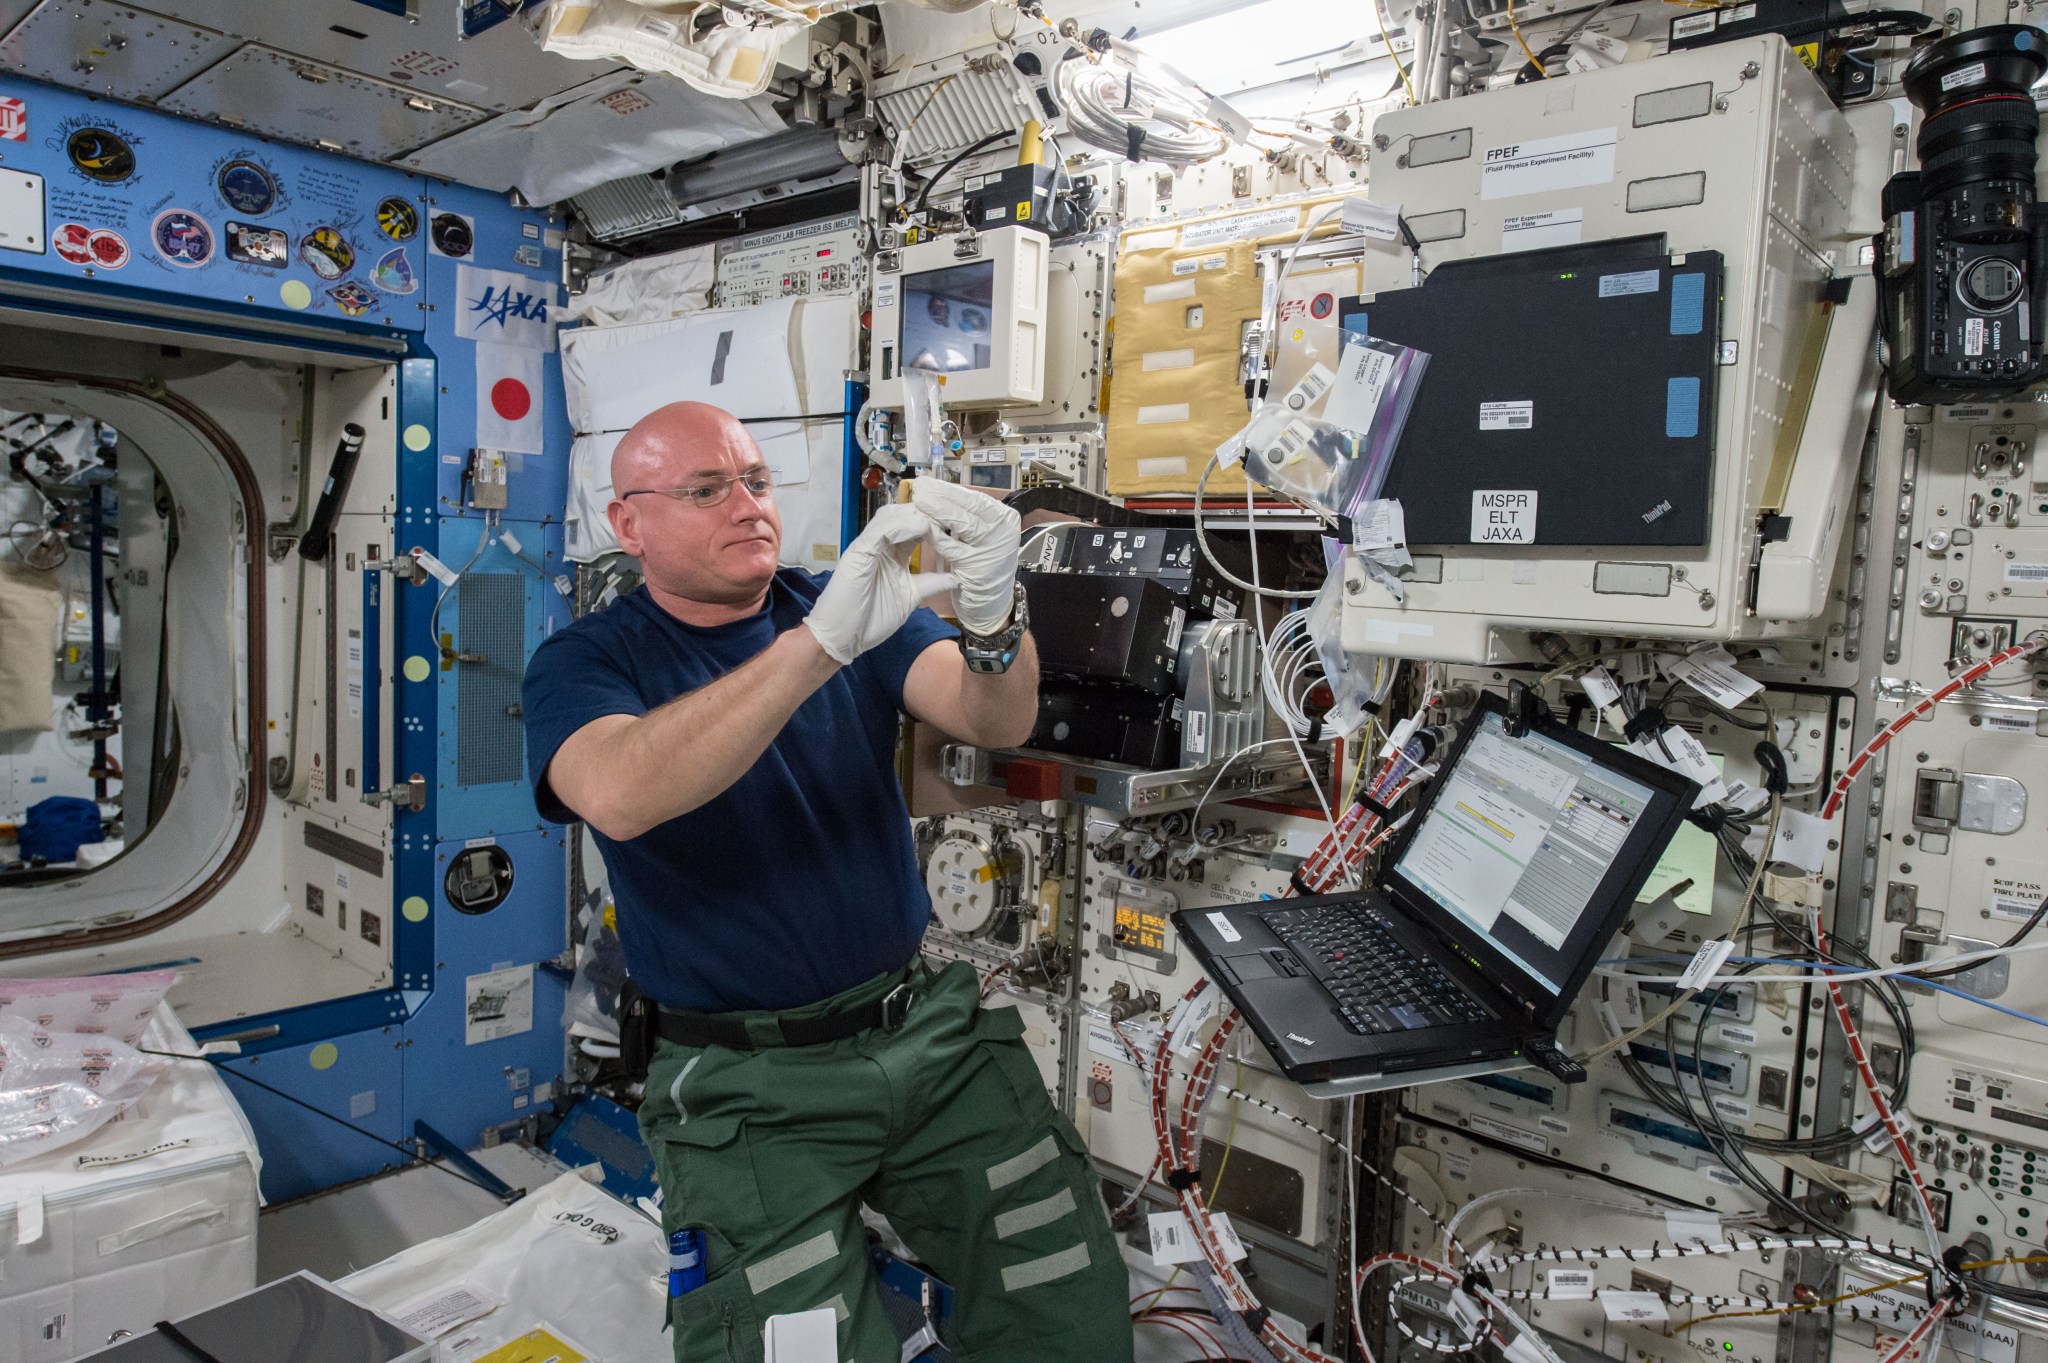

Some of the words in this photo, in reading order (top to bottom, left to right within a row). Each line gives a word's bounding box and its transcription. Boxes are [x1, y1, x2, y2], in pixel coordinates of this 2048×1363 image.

[1486, 146, 1520, 160] FPEF
[1485, 164, 1503, 174] (Fluid
[1504, 161, 1529, 170] Physics
[1530, 155, 1567, 166] Experiment
[1568, 150, 1594, 161] Facility)
[1520, 212, 1552, 221] Experiment
[1212, 228, 1224, 236] UNIT
[1270, 216, 1296, 226] MICRO-G)
[744, 238, 761, 248] MINUS
[762, 235, 782, 244] EIGHTY
[782, 232, 794, 240] LAB
[795, 226, 822, 236] FREEZER
[822, 222, 832, 232] ISS
[90, 238, 124, 254] Kibo
[465, 284, 547, 331] JAXA
[1994, 320, 2002, 350] Canon
[1482, 494, 1528, 508] MSPR
[1490, 511, 1518, 524] ELT
[1641, 500, 1672, 524] ThinkPad
[1482, 528, 1522, 540] JAXA
[1210, 884, 1226, 892] CELL
[1230, 888, 1256, 898] BIOLOGY
[2016, 882, 2041, 890] PASS
[1210, 892, 1237, 903] CONTROL
[1992, 888, 2014, 896] THRU
[2016, 892, 2043, 900] PLATE
[1090, 1030, 1113, 1044] AVIONICS
[1286, 1032, 1316, 1046] ThinkPad
[580, 1218, 594, 1226] G
[1898, 1302, 1916, 1312] AIR
[1982, 1330, 2016, 1347] (AAA)
